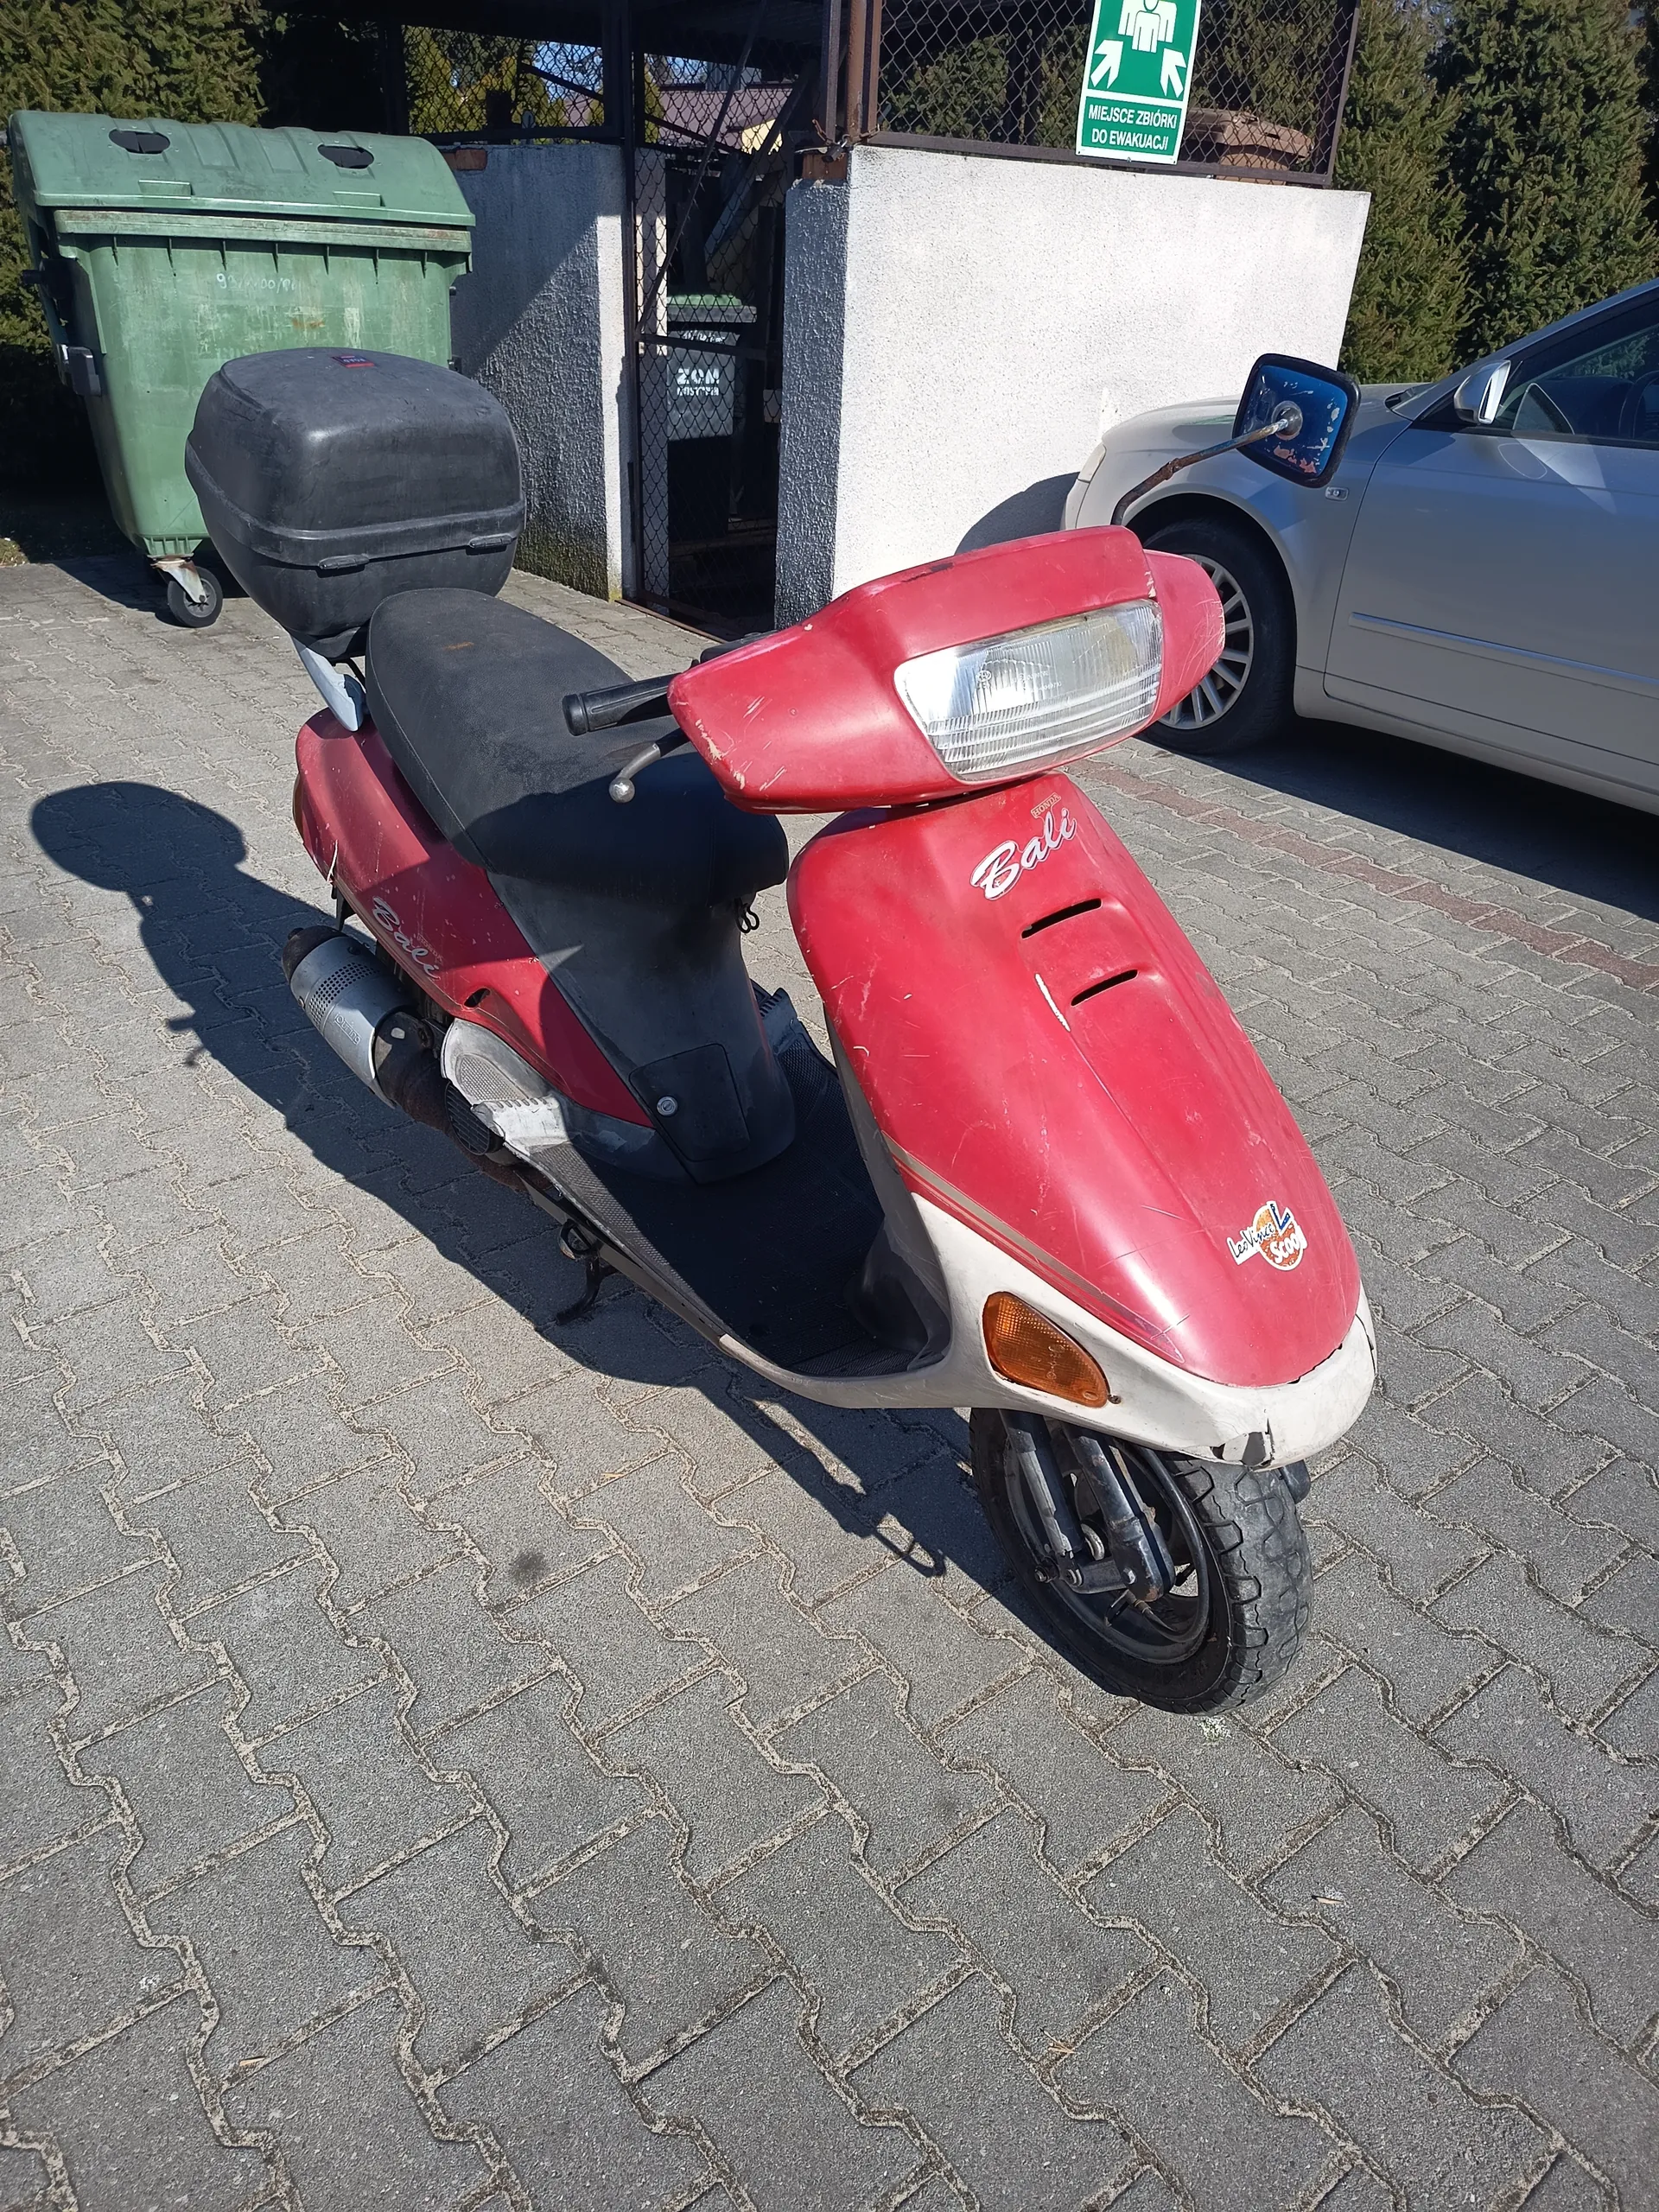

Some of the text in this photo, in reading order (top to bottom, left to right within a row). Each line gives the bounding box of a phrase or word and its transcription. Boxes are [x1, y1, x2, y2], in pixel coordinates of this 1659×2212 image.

[1088, 104, 1178, 130] MIEJSCE ZBIÓRKI
[1091, 128, 1170, 151] DO EWAKUACJI
[1033, 793, 1060, 817] HONDA
[970, 808, 1077, 900] Bali
[372, 896, 442, 981] Bali
